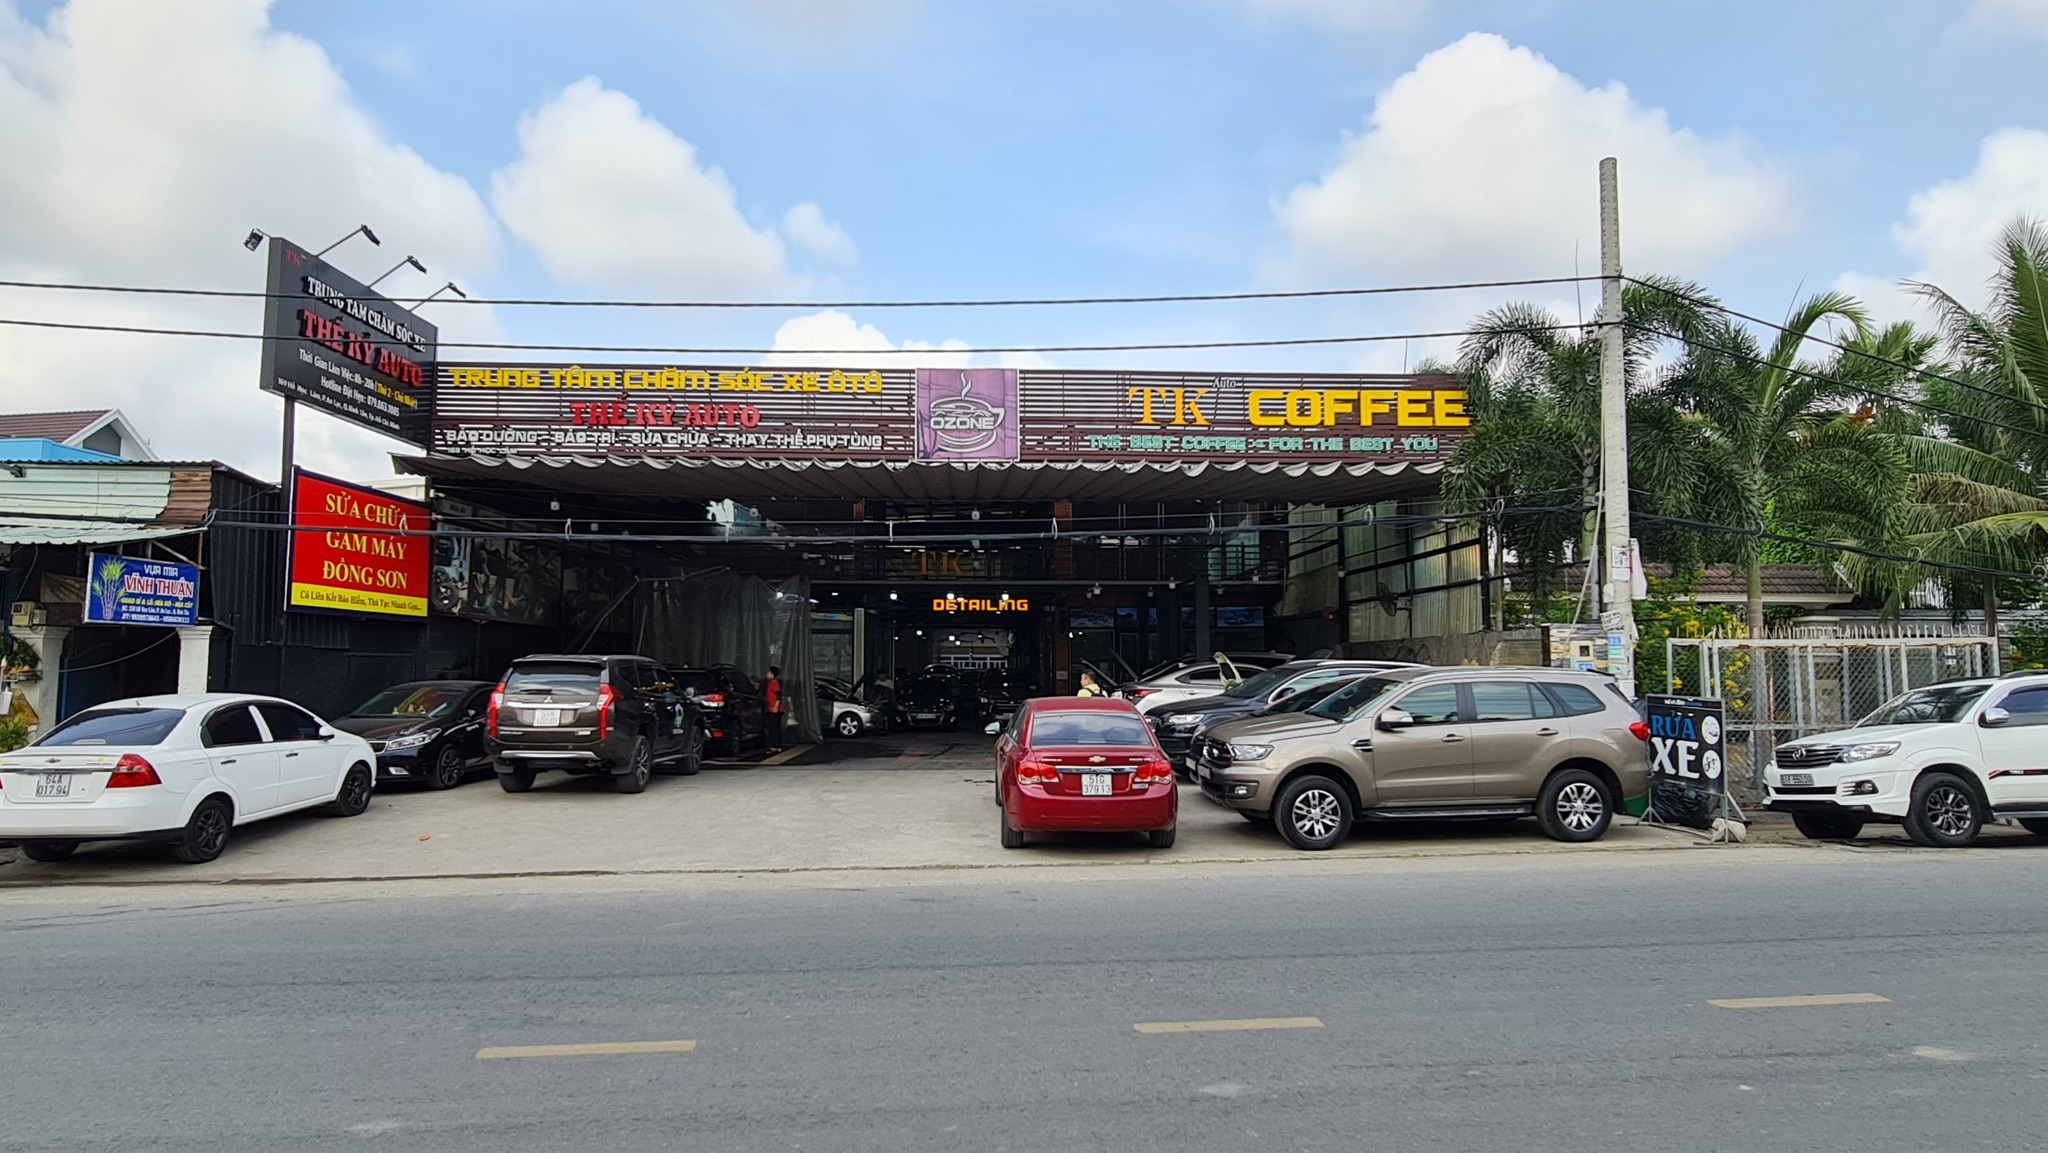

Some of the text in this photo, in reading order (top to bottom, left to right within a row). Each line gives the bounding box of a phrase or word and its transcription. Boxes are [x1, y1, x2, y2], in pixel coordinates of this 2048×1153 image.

[308, 276, 345, 309] TRUNG
[378, 347, 423, 388] AUTO
[448, 368, 541, 389] TRUNG
[548, 365, 616, 390] TÂM
[623, 367, 710, 391] CHĂM
[717, 367, 774, 392] SÓC
[783, 373, 821, 393] XE
[1211, 376, 1237, 389] Auto
[570, 391, 629, 426] THẾ
[684, 403, 762, 428] AUTO
[1128, 387, 1472, 428] TK COFFEE
[930, 417, 995, 430] OZONE
[728, 433, 769, 446] THAY
[840, 430, 883, 447] TÙNG
[1088, 434, 1122, 449] THE
[1130, 434, 1174, 449] BEST
[1182, 435, 1247, 451] COFFEE
[1269, 436, 1304, 451] FOR
[1312, 437, 1344, 451] THE
[1351, 437, 1395, 451] BEST
[1402, 437, 1438, 451] YOU
[325, 491, 362, 519] SỬA
[371, 536, 408, 560] MÁY
[912, 551, 964, 577] TK
[124, 572, 194, 600] VĨNH THUẬN
[376, 569, 408, 590] SƠN
[300, 590, 309, 599] Có
[310, 591, 325, 601] Liên
[933, 599, 1029, 611] DETAILING
[1651, 710, 1697, 740] RỬA
[1651, 737, 1700, 779] XE
